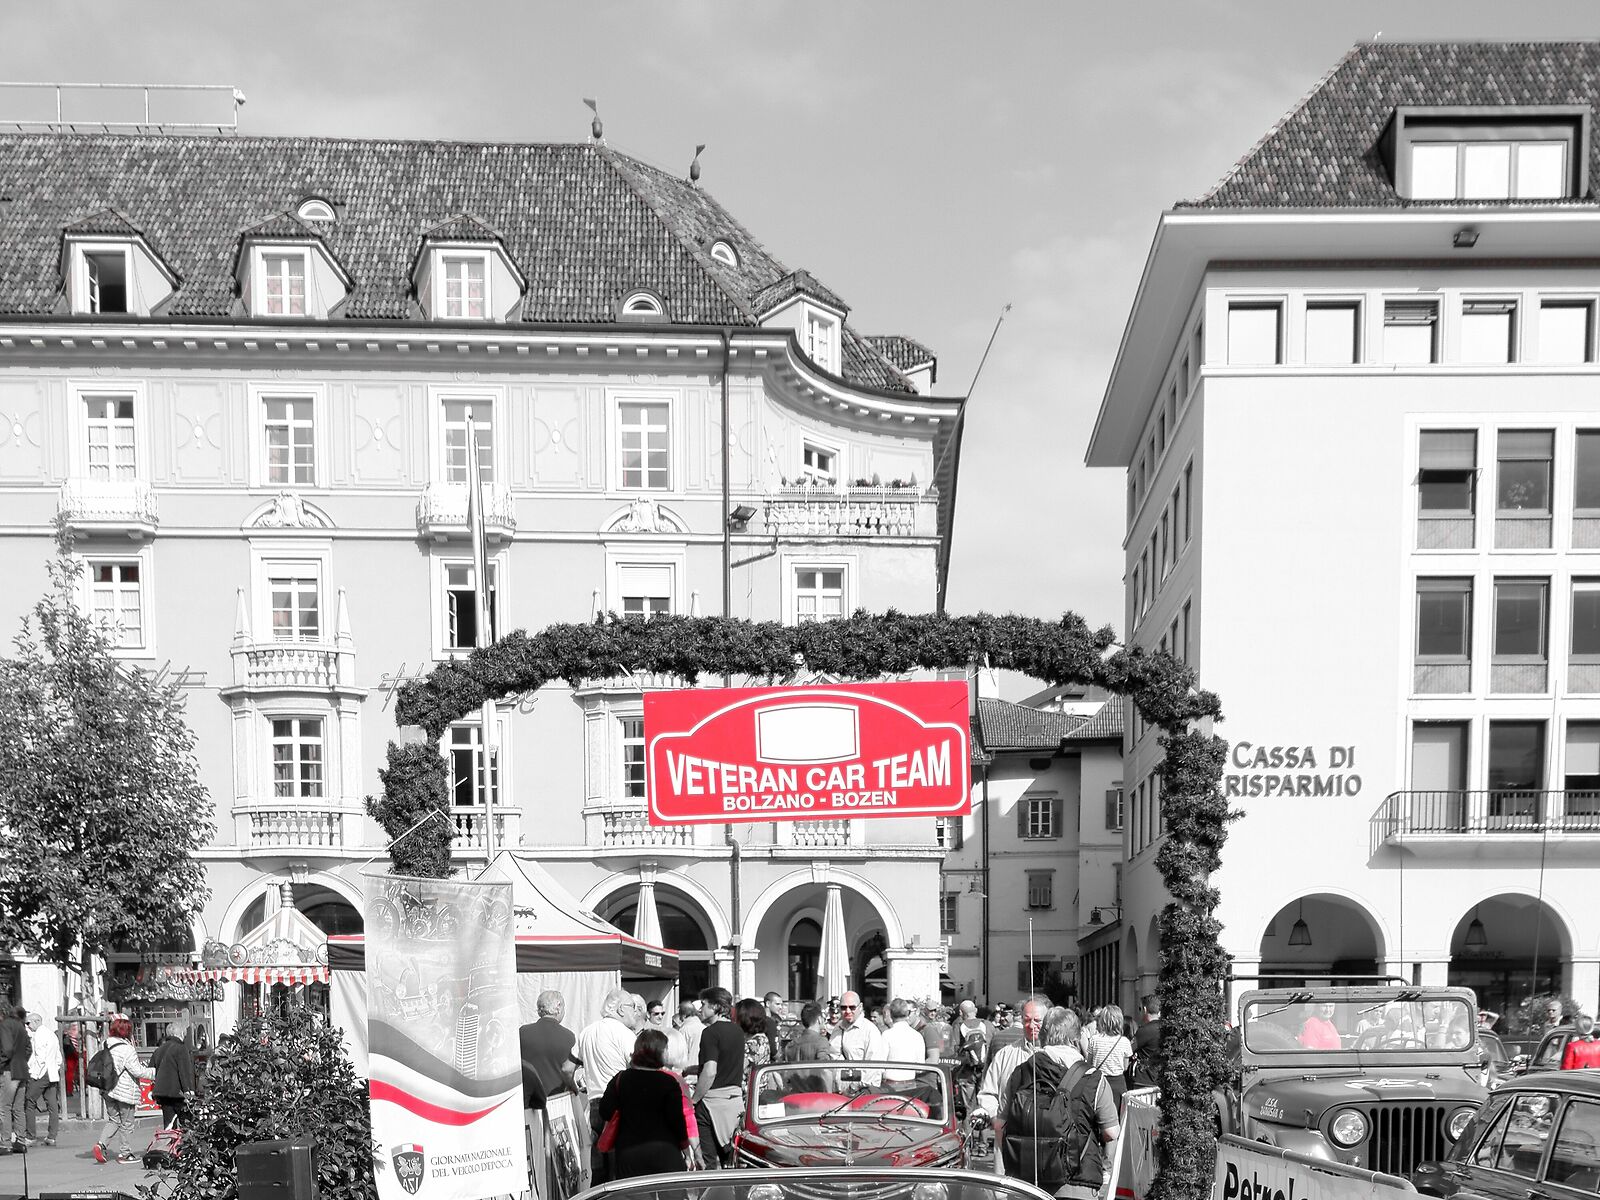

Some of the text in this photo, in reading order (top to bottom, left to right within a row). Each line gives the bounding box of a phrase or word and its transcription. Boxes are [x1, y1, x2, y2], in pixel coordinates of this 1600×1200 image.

[666, 738, 952, 796] VETERAN CAR TEAM
[1224, 774, 1363, 798] RISPARMIO
[723, 793, 815, 812] BOLZANO
[831, 790, 897, 808] BOZEN
[431, 1168, 450, 1179] DEL
